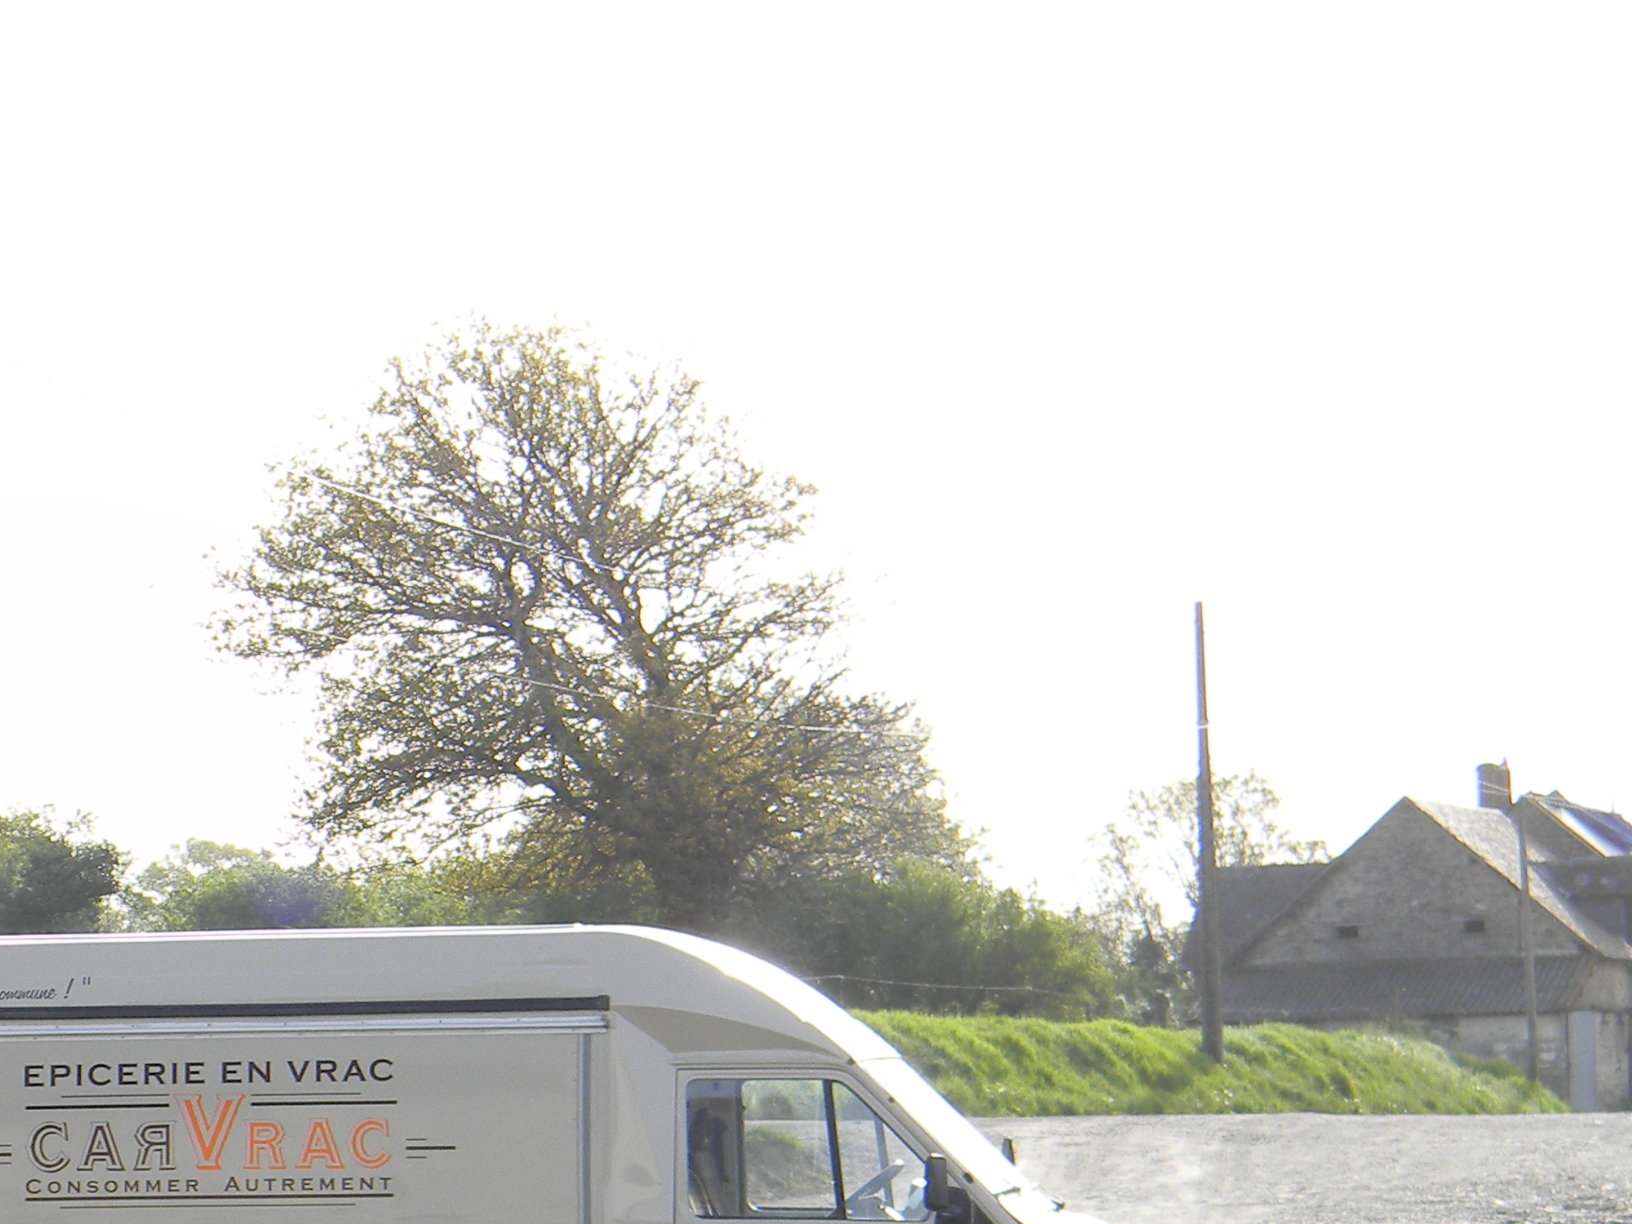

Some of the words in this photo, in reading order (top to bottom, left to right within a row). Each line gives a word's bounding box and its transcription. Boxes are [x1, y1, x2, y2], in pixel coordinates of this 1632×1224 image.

[23, 1062, 206, 1088] EPICERIE
[220, 1060, 271, 1084] EN
[287, 1058, 395, 1082] VRAC
